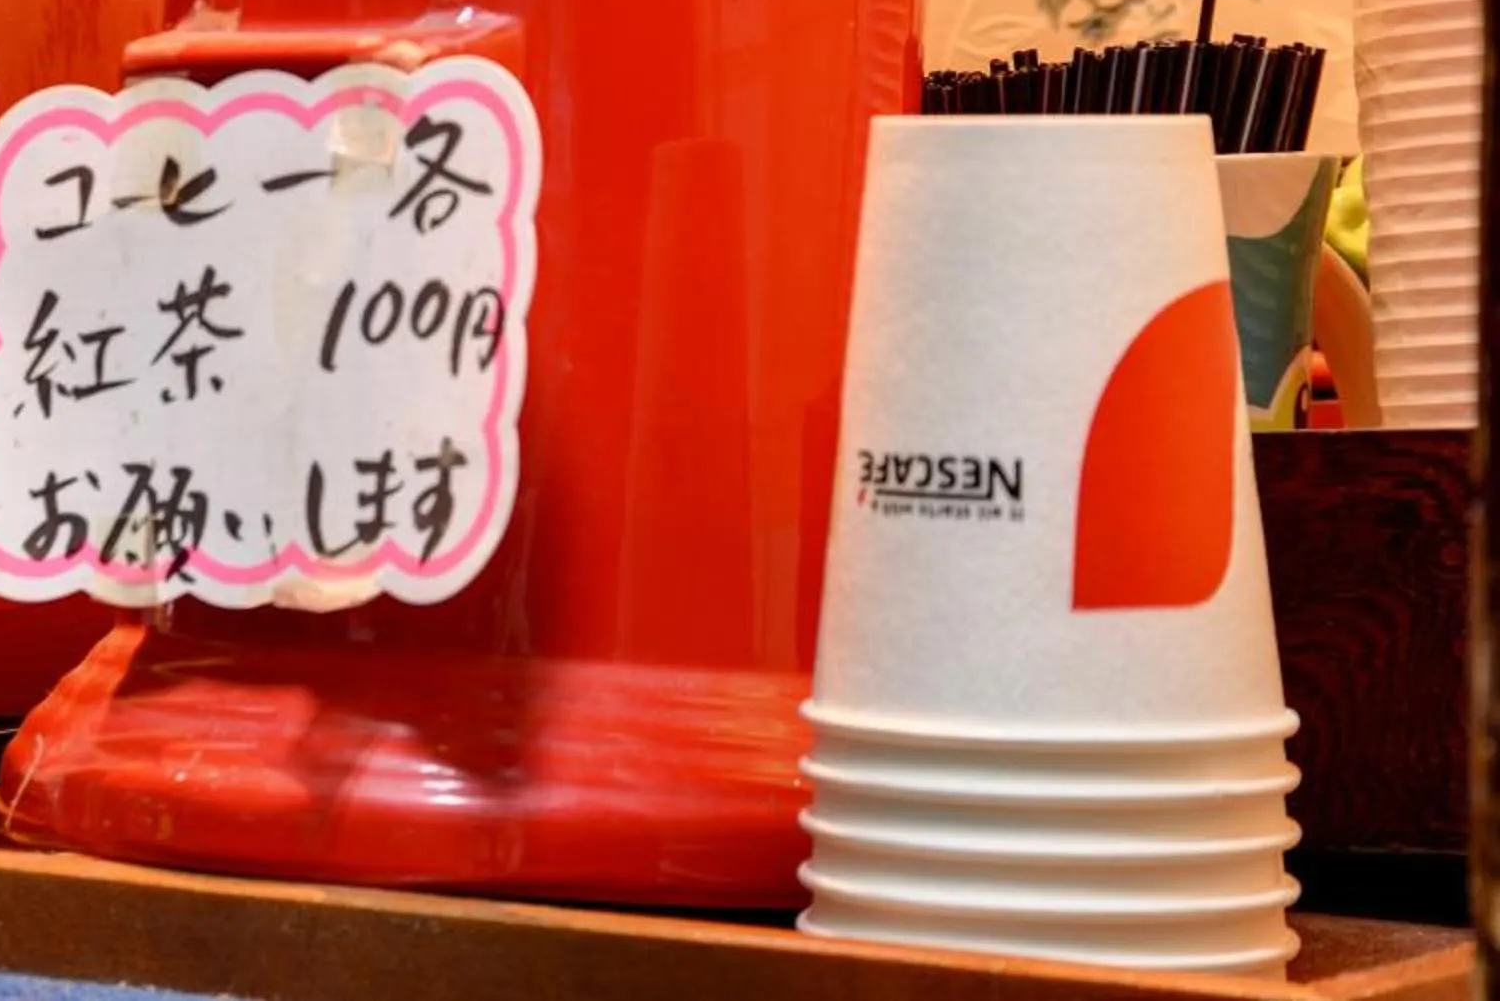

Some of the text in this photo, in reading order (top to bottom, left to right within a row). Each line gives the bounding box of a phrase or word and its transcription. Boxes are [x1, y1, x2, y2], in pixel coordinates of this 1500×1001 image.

[388, 115, 493, 235] 各
[13, 265, 506, 419] 紅茶 100円
[21, 436, 470, 583] お願いします
